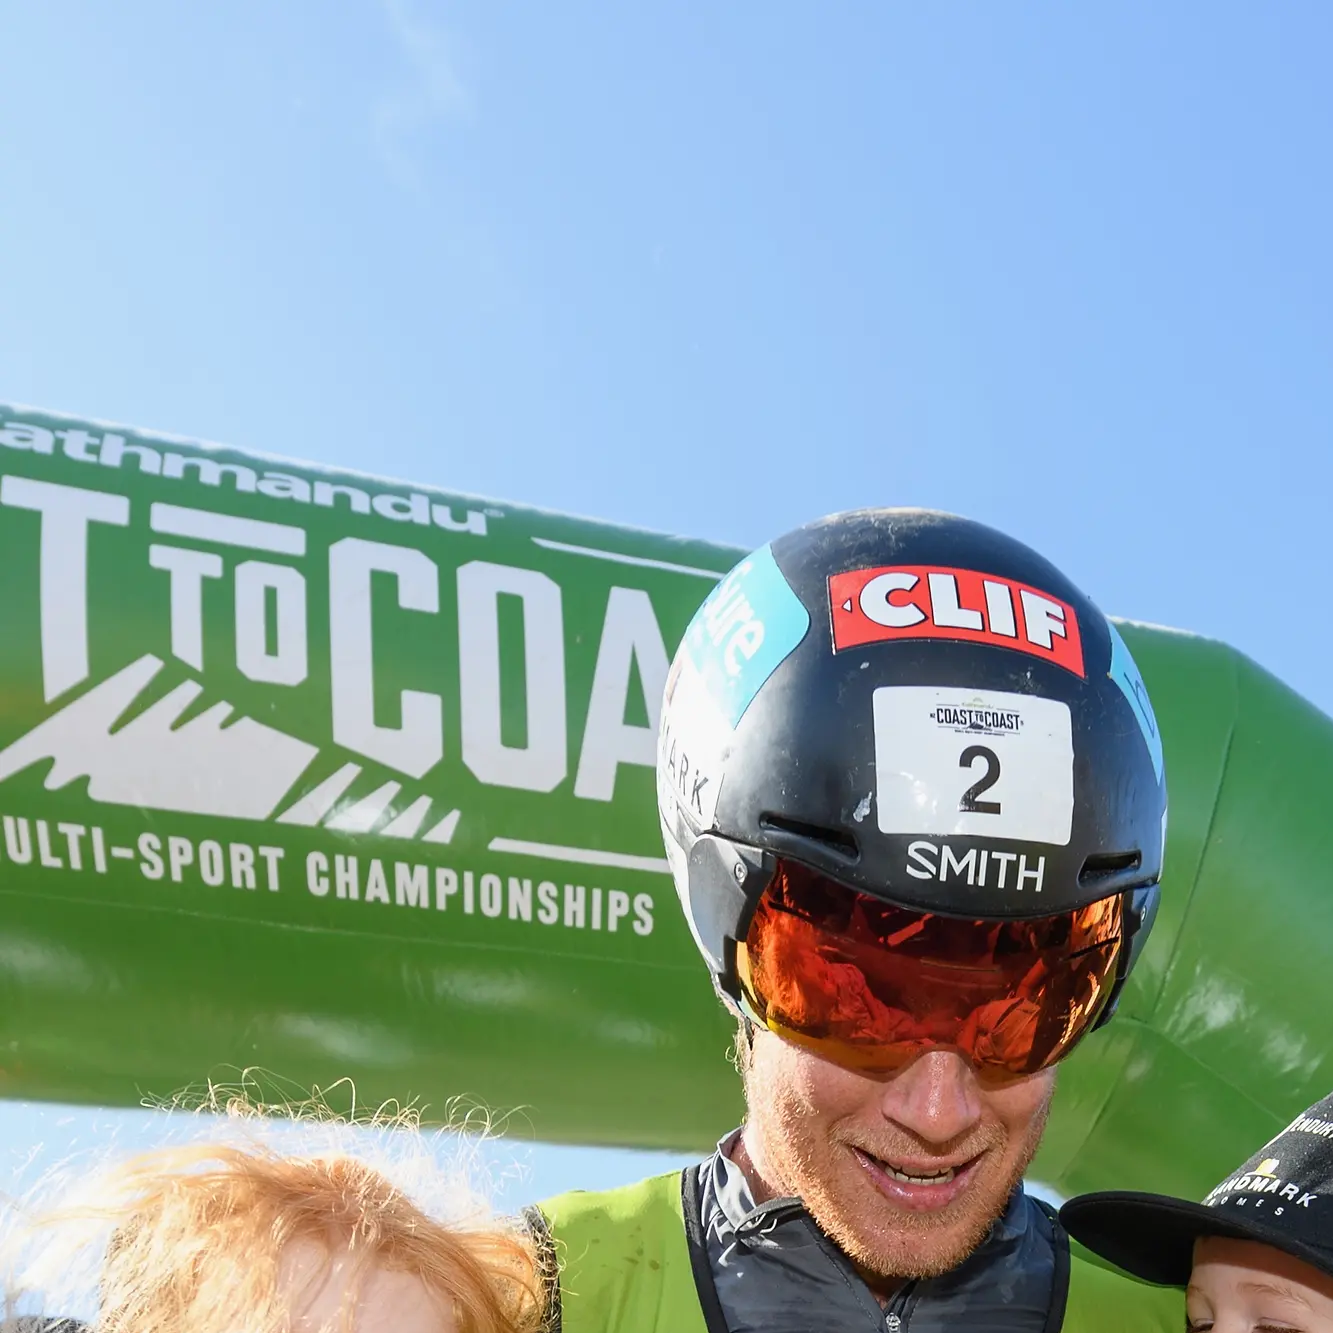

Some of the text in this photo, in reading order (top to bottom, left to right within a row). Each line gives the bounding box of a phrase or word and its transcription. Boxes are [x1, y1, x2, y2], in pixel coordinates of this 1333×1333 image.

[0, 421, 487, 535] athmandu
[2, 475, 129, 704] T
[149, 544, 307, 686] TO
[858, 571, 1066, 651] CLIF
[936, 708, 973, 725] COAST
[984, 712, 1020, 730] COAST
[959, 745, 1001, 815] 2
[306, 851, 655, 936] CHAMPIONSHIPS
[906, 840, 1045, 892] SMITH
